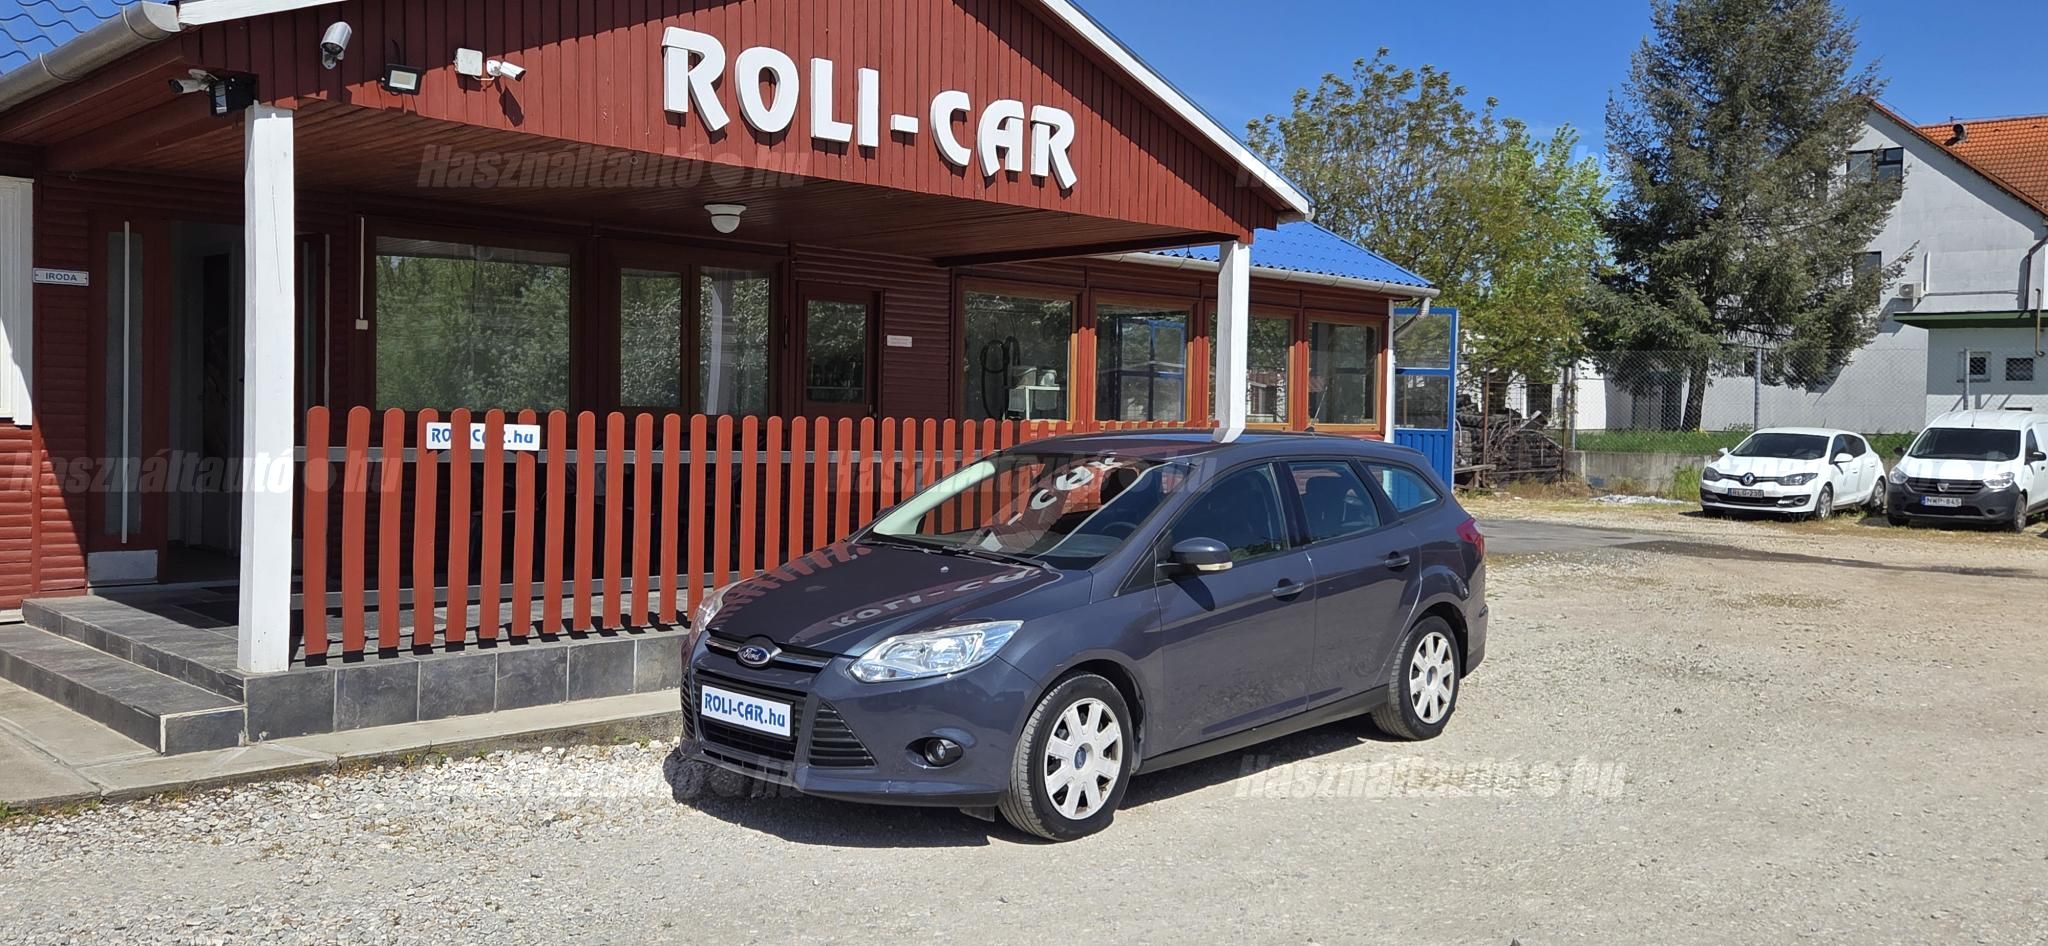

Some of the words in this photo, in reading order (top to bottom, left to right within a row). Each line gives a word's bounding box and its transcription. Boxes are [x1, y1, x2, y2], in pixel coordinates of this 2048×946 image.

[661, 26, 1077, 190] ROLI-CAR
[45, 272, 78, 281] IRODA
[742, 647, 762, 661] Ford
[704, 692, 786, 728] ROLI-CAR.hu
